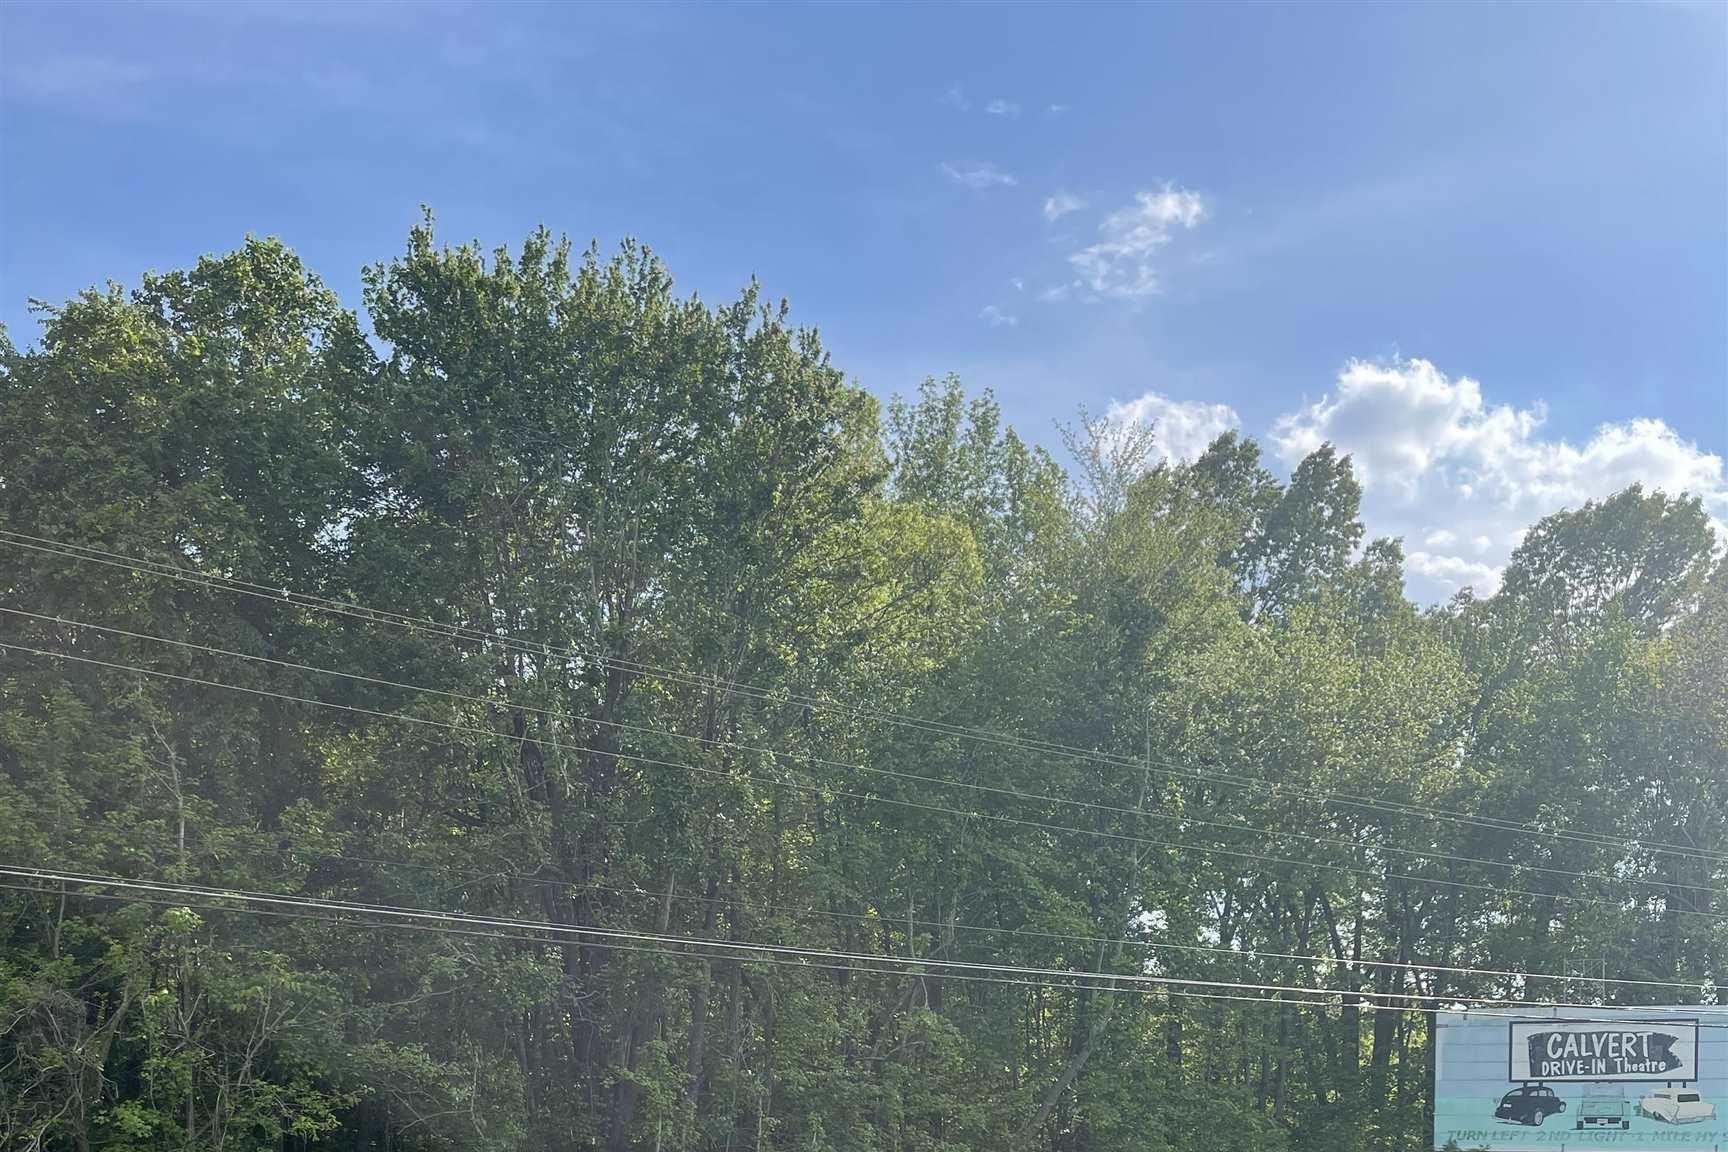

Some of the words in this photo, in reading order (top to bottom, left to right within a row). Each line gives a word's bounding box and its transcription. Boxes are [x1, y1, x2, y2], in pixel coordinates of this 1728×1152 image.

[1546, 1032, 1653, 1059] CALVERT
[1541, 1059, 1606, 1076] DRIVE-IN
[1614, 1057, 1666, 1073] Theatre
[1447, 1130, 1488, 1142] TURN
[1491, 1130, 1529, 1141] LEFT
[1536, 1130, 1570, 1142] 2ND
[1578, 1131, 1625, 1142] LIGHT
